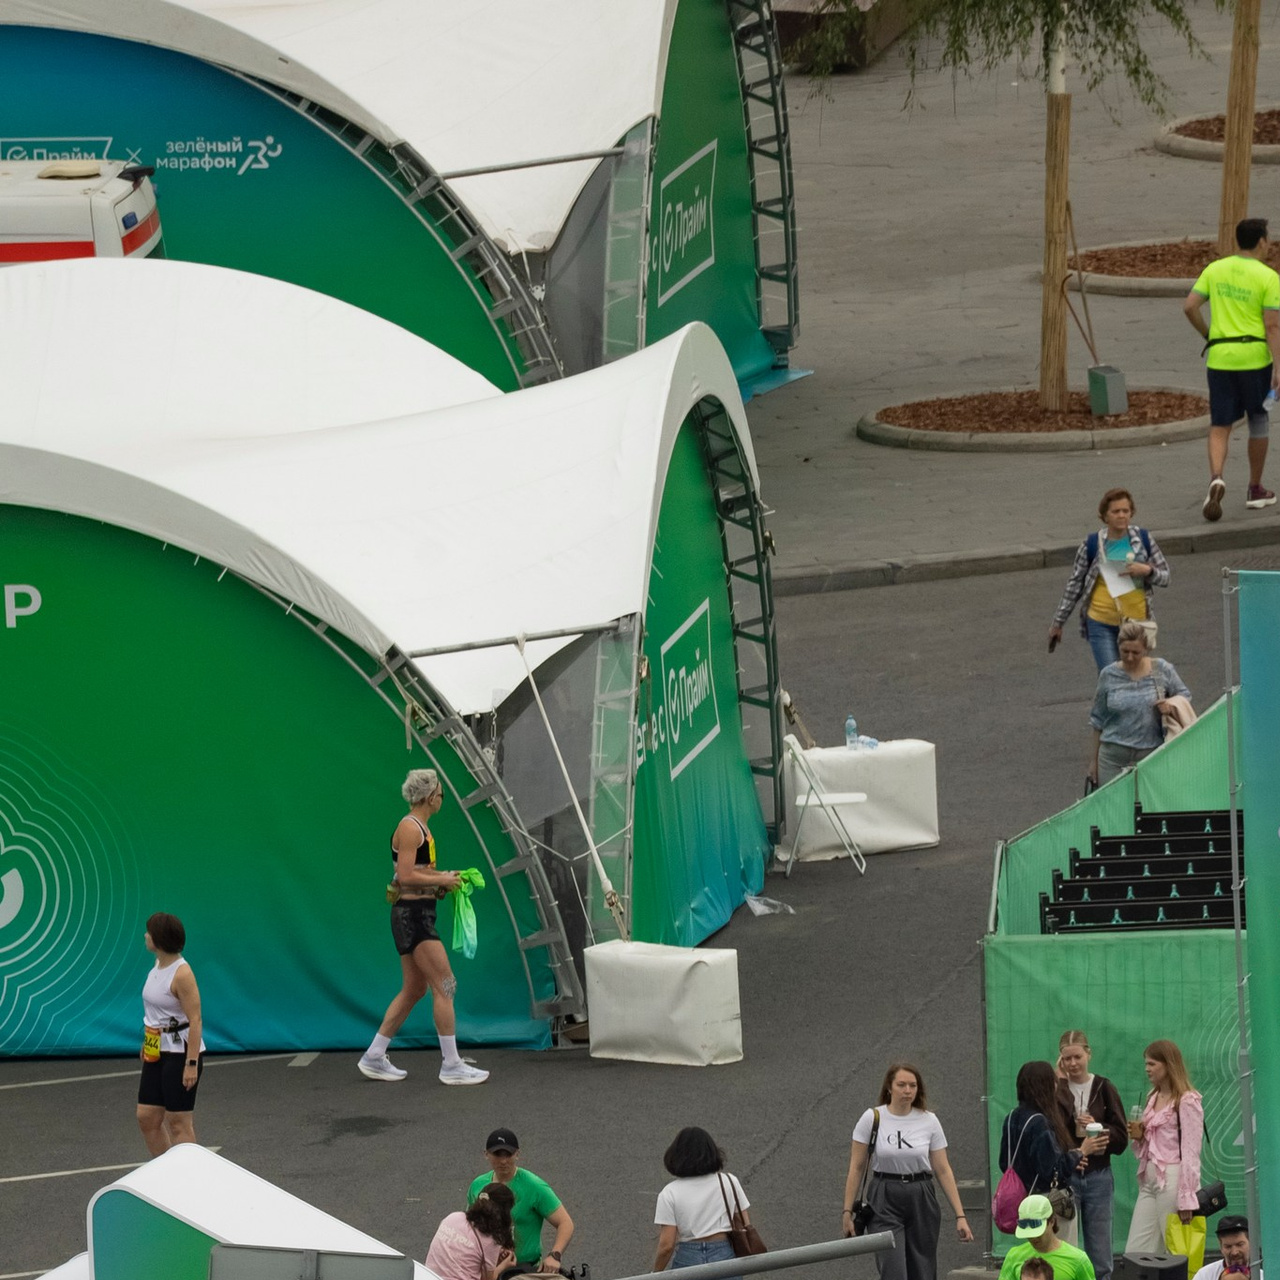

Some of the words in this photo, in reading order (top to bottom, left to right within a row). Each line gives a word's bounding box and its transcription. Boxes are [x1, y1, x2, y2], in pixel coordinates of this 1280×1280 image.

[156, 153, 236, 171] марафон
[165, 136, 243, 154] зелёный
[674, 184, 707, 259] Прайм
[679, 647, 710, 728] Прайм
